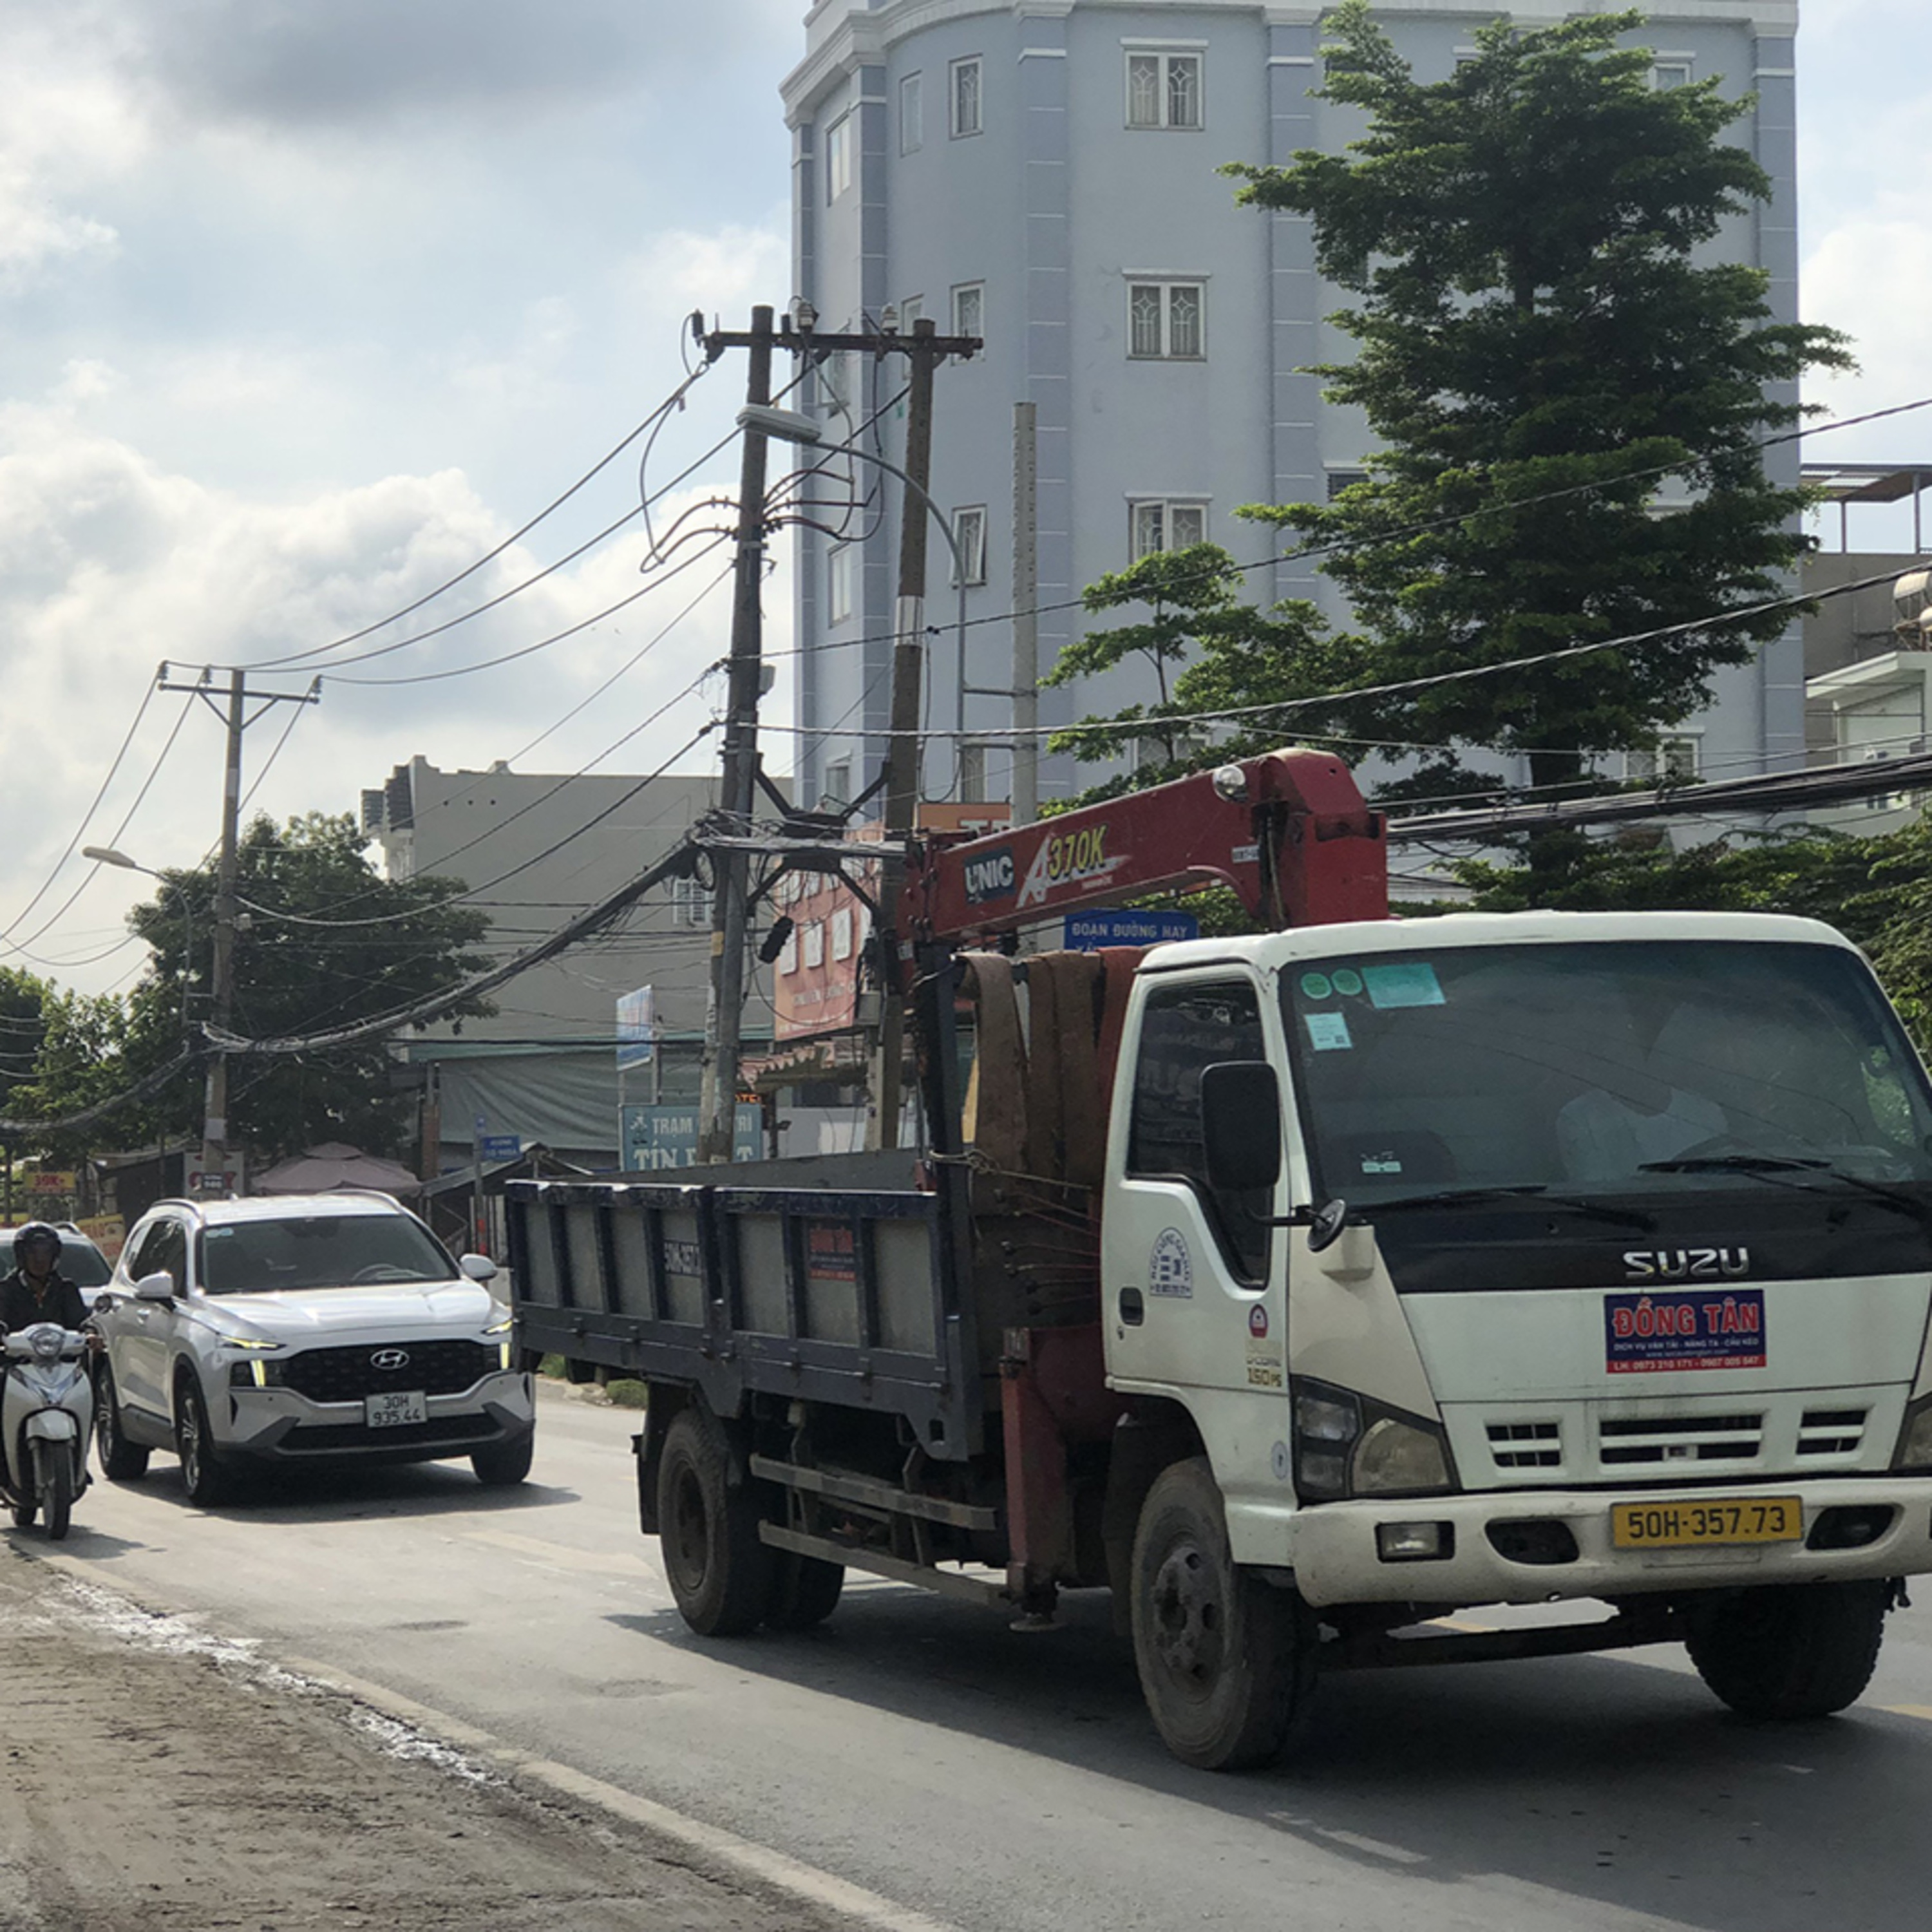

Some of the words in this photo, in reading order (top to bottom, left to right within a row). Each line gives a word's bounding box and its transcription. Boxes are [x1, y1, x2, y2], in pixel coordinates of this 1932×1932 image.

[965, 855, 1014, 894] UNIC
[1162, 925, 1188, 938] HAY
[652, 1117, 692, 1137] TRẠM
[1623, 1247, 1749, 1278] SUZU
[383, 1396, 410, 1410] 30H
[373, 1408, 420, 1425] 935.44
[1628, 1506, 1786, 1539] 50H-357.73
